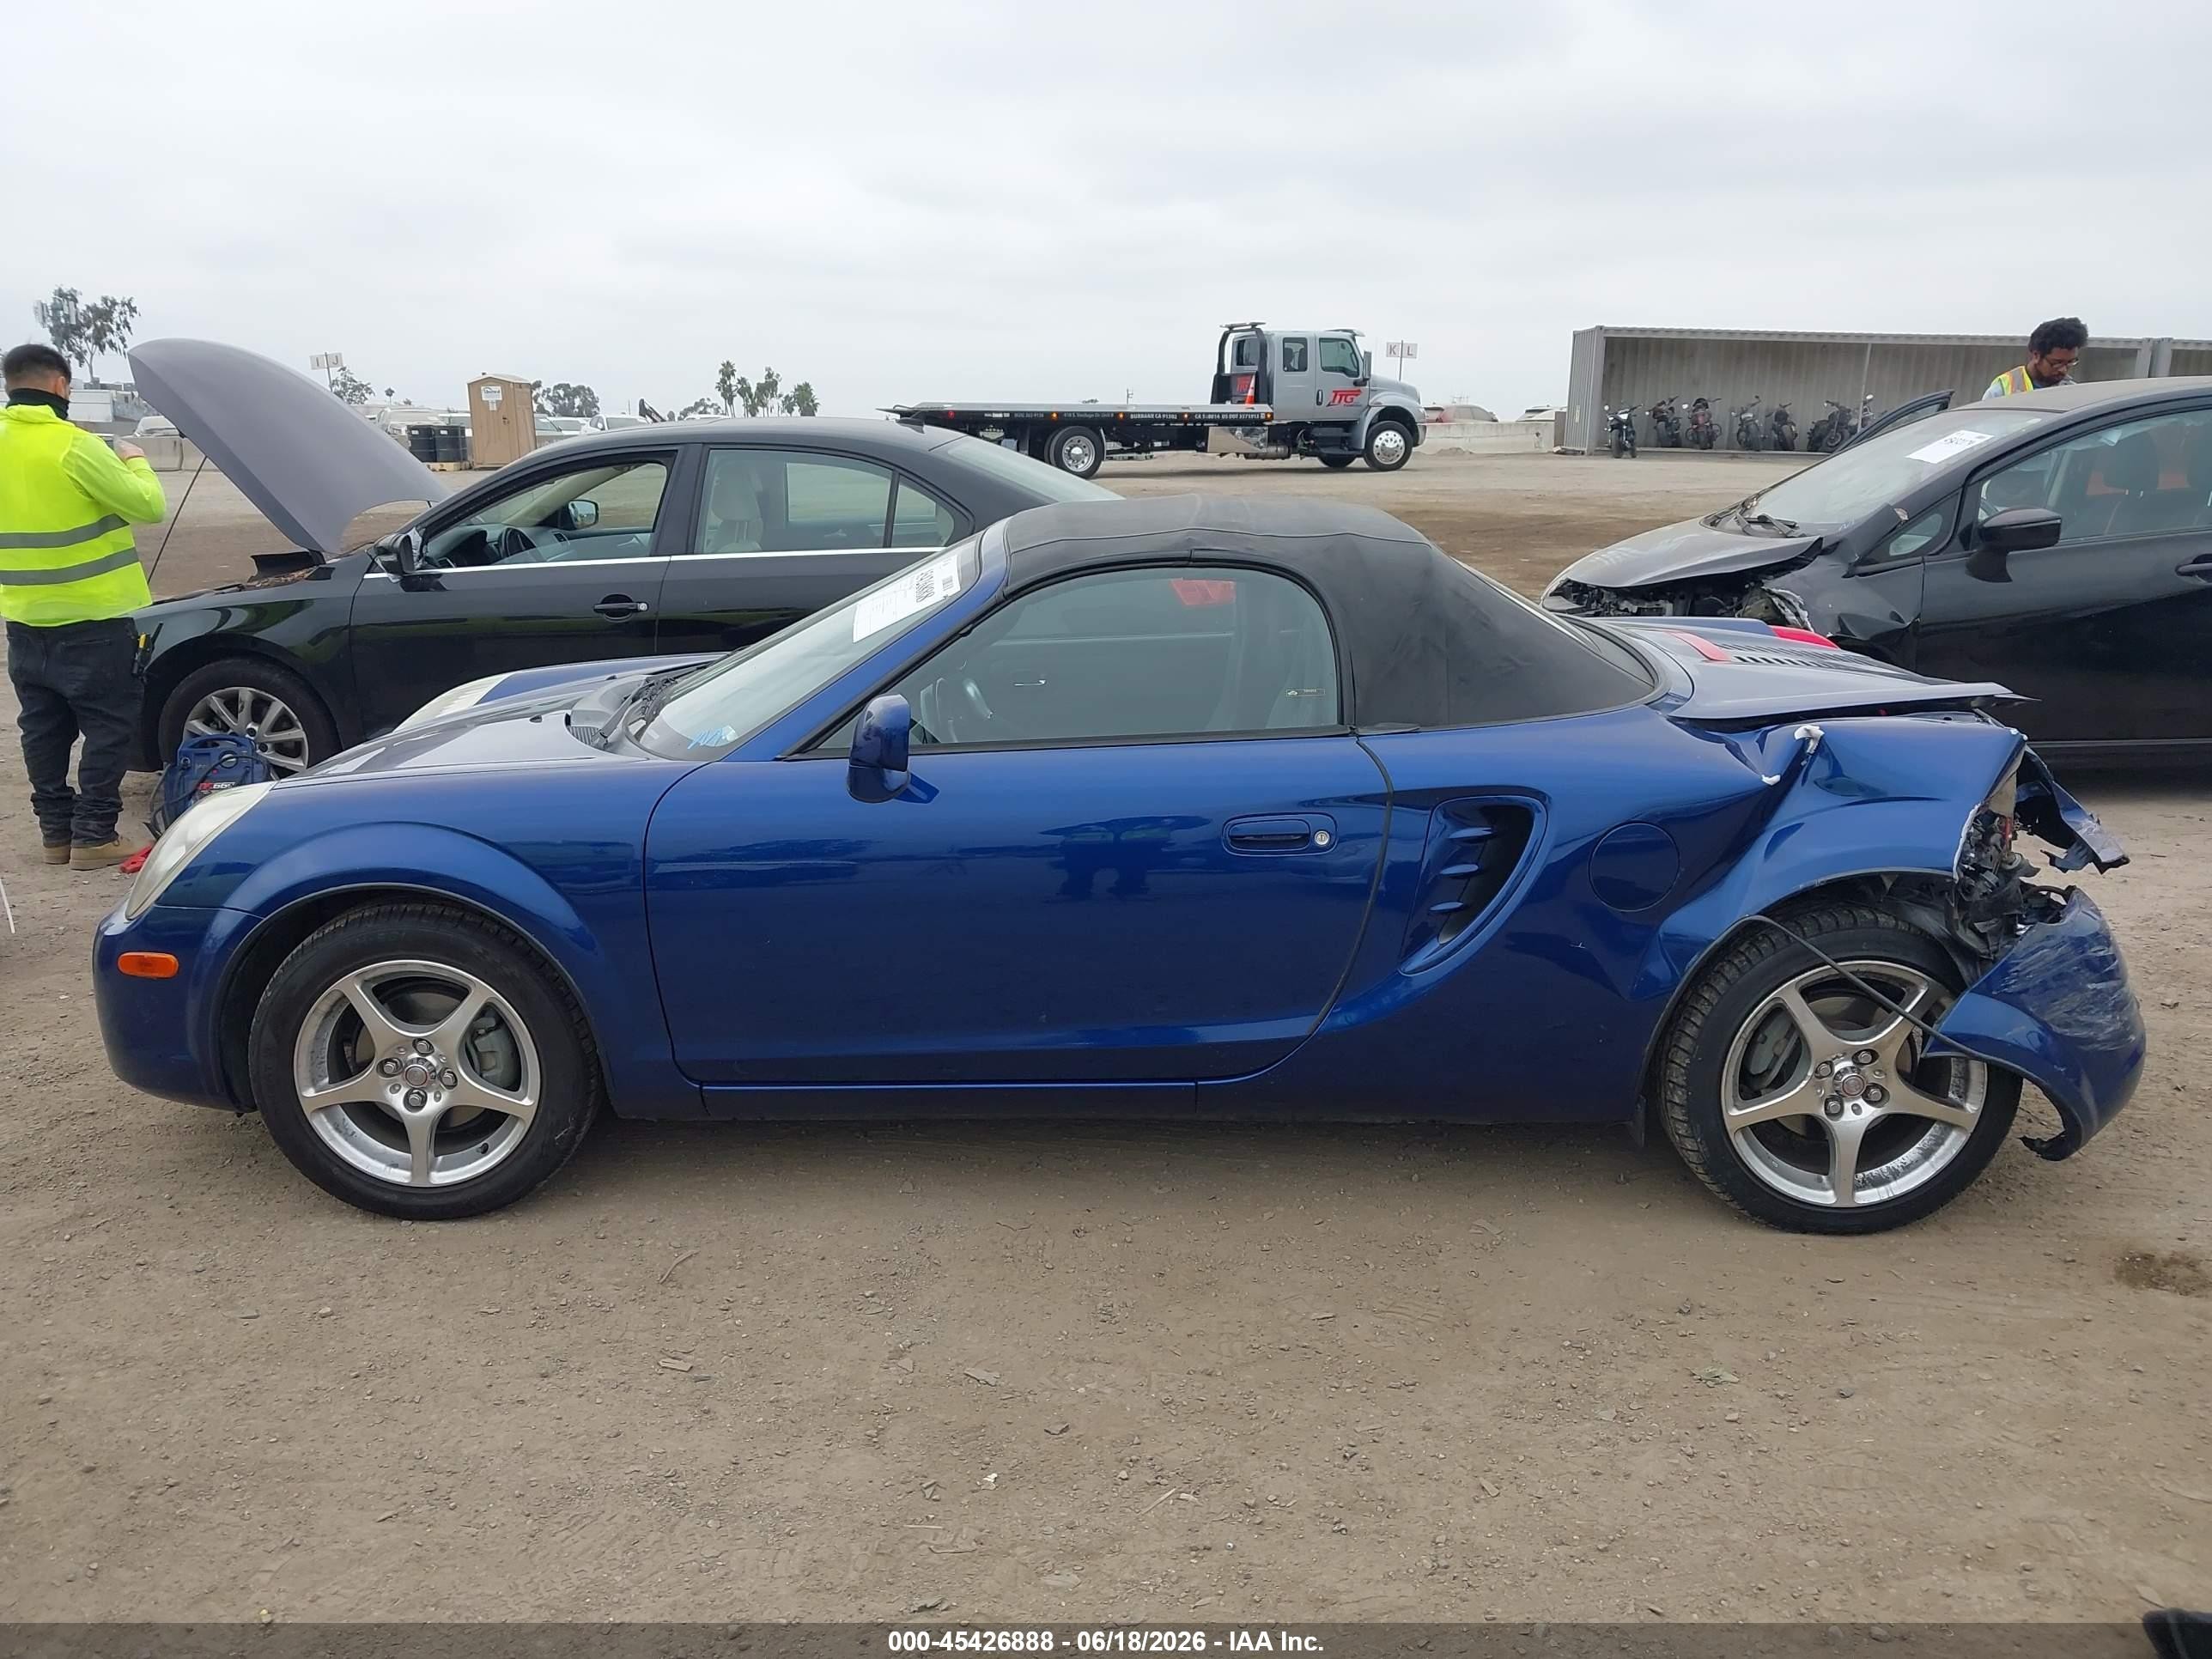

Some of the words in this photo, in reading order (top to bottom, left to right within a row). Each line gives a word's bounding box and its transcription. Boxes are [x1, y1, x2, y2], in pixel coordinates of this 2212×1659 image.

[1389, 344, 1396, 356] K
[1407, 345, 1413, 356] L
[332, 355, 338, 365] J
